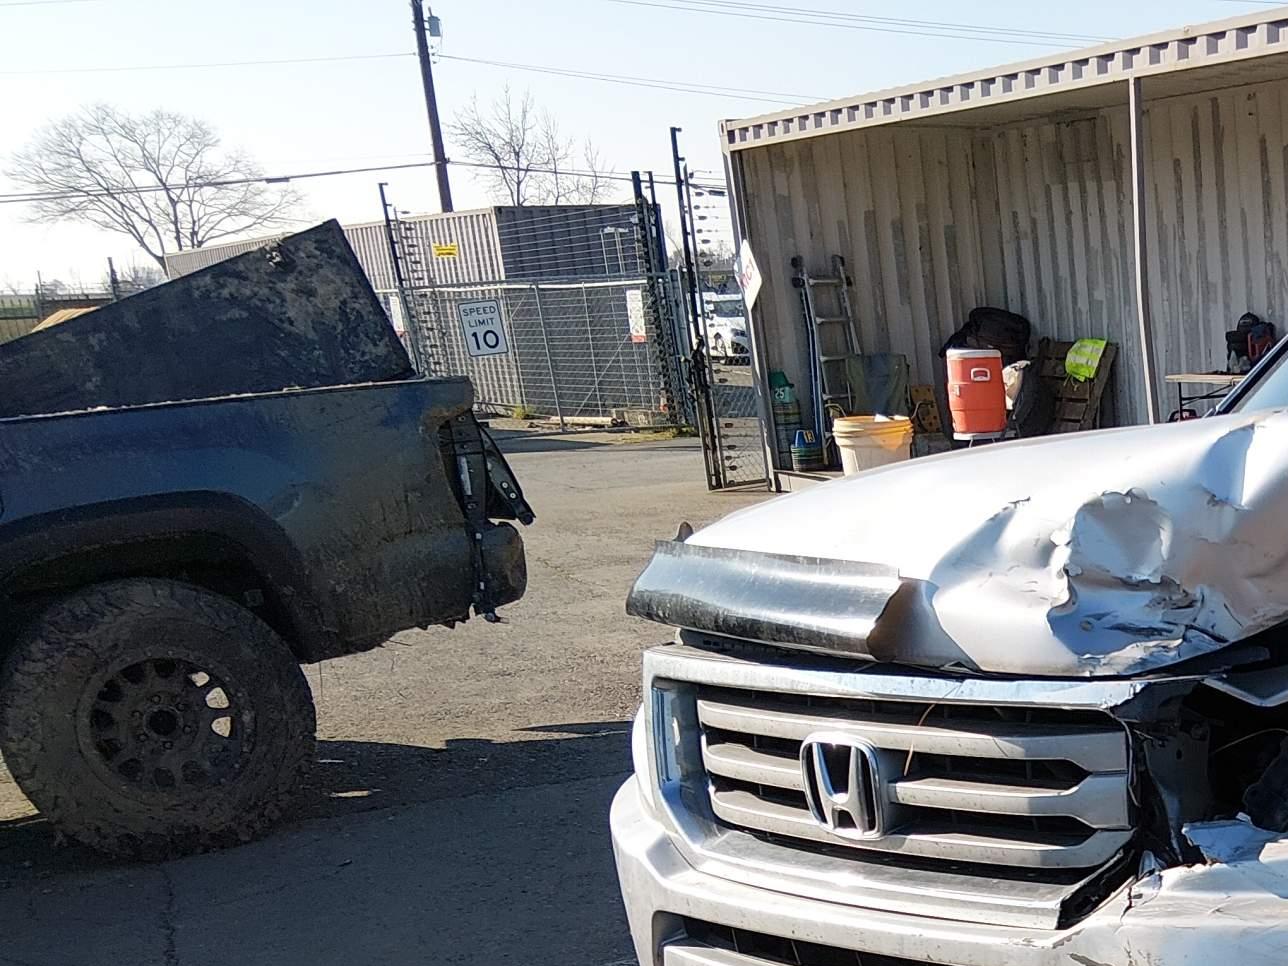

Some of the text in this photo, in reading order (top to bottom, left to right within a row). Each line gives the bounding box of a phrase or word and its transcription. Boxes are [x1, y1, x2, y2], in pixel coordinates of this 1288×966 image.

[462, 305, 497, 317] SPEED
[468, 317, 495, 328] LIMIT
[471, 329, 500, 351] 10
